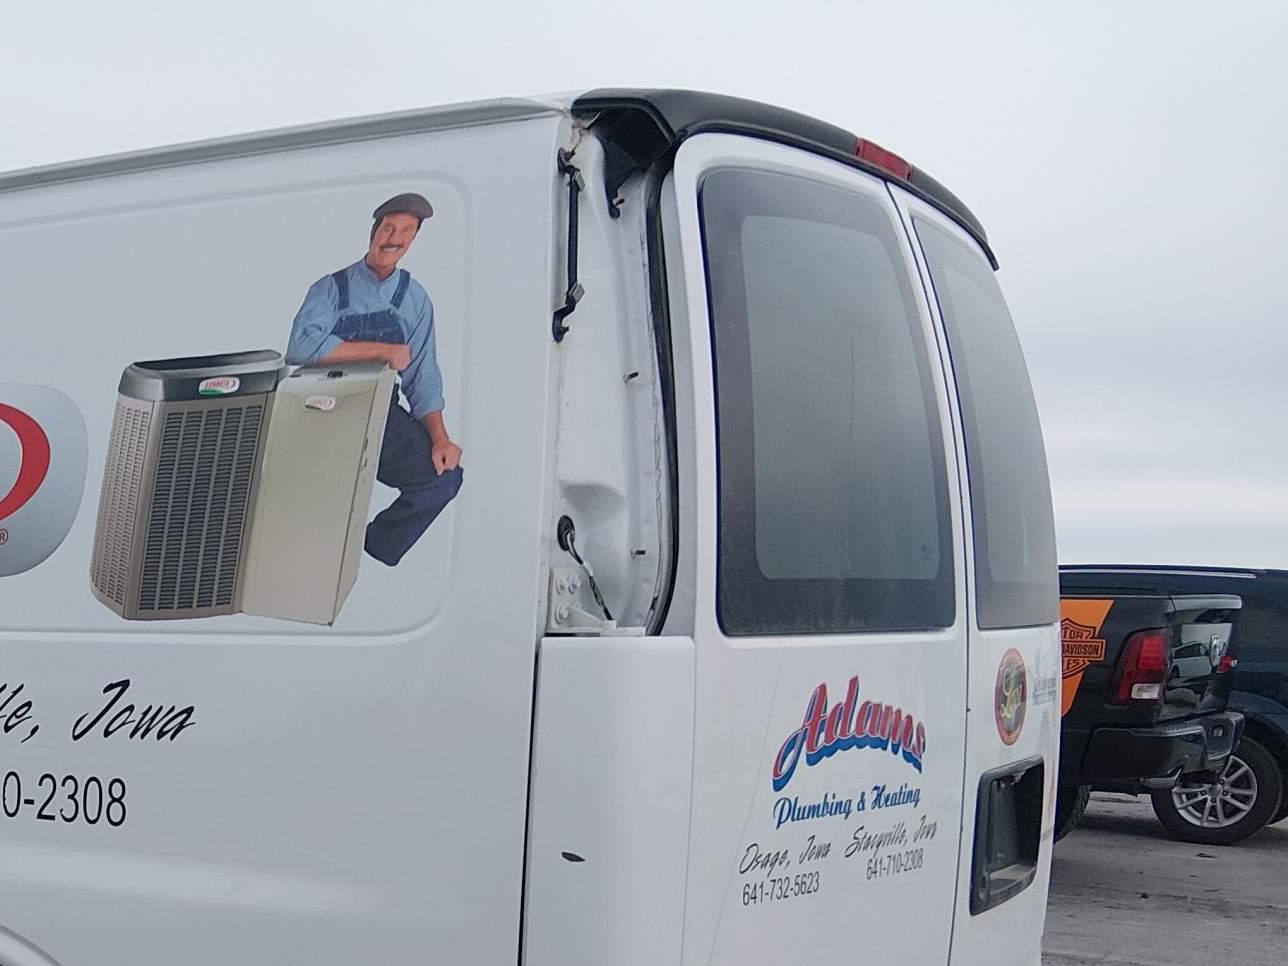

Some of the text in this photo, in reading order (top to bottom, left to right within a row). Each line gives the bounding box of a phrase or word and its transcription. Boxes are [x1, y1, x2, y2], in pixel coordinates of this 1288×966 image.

[71, 679, 197, 743] Iowa
[772, 675, 926, 792] Adams
[773, 783, 921, 830] Plumbing & Heating
[739, 843, 791, 877] Osage,
[866, 848, 924, 880] 641-710-2308
[742, 871, 820, 906] 641-732-5623
